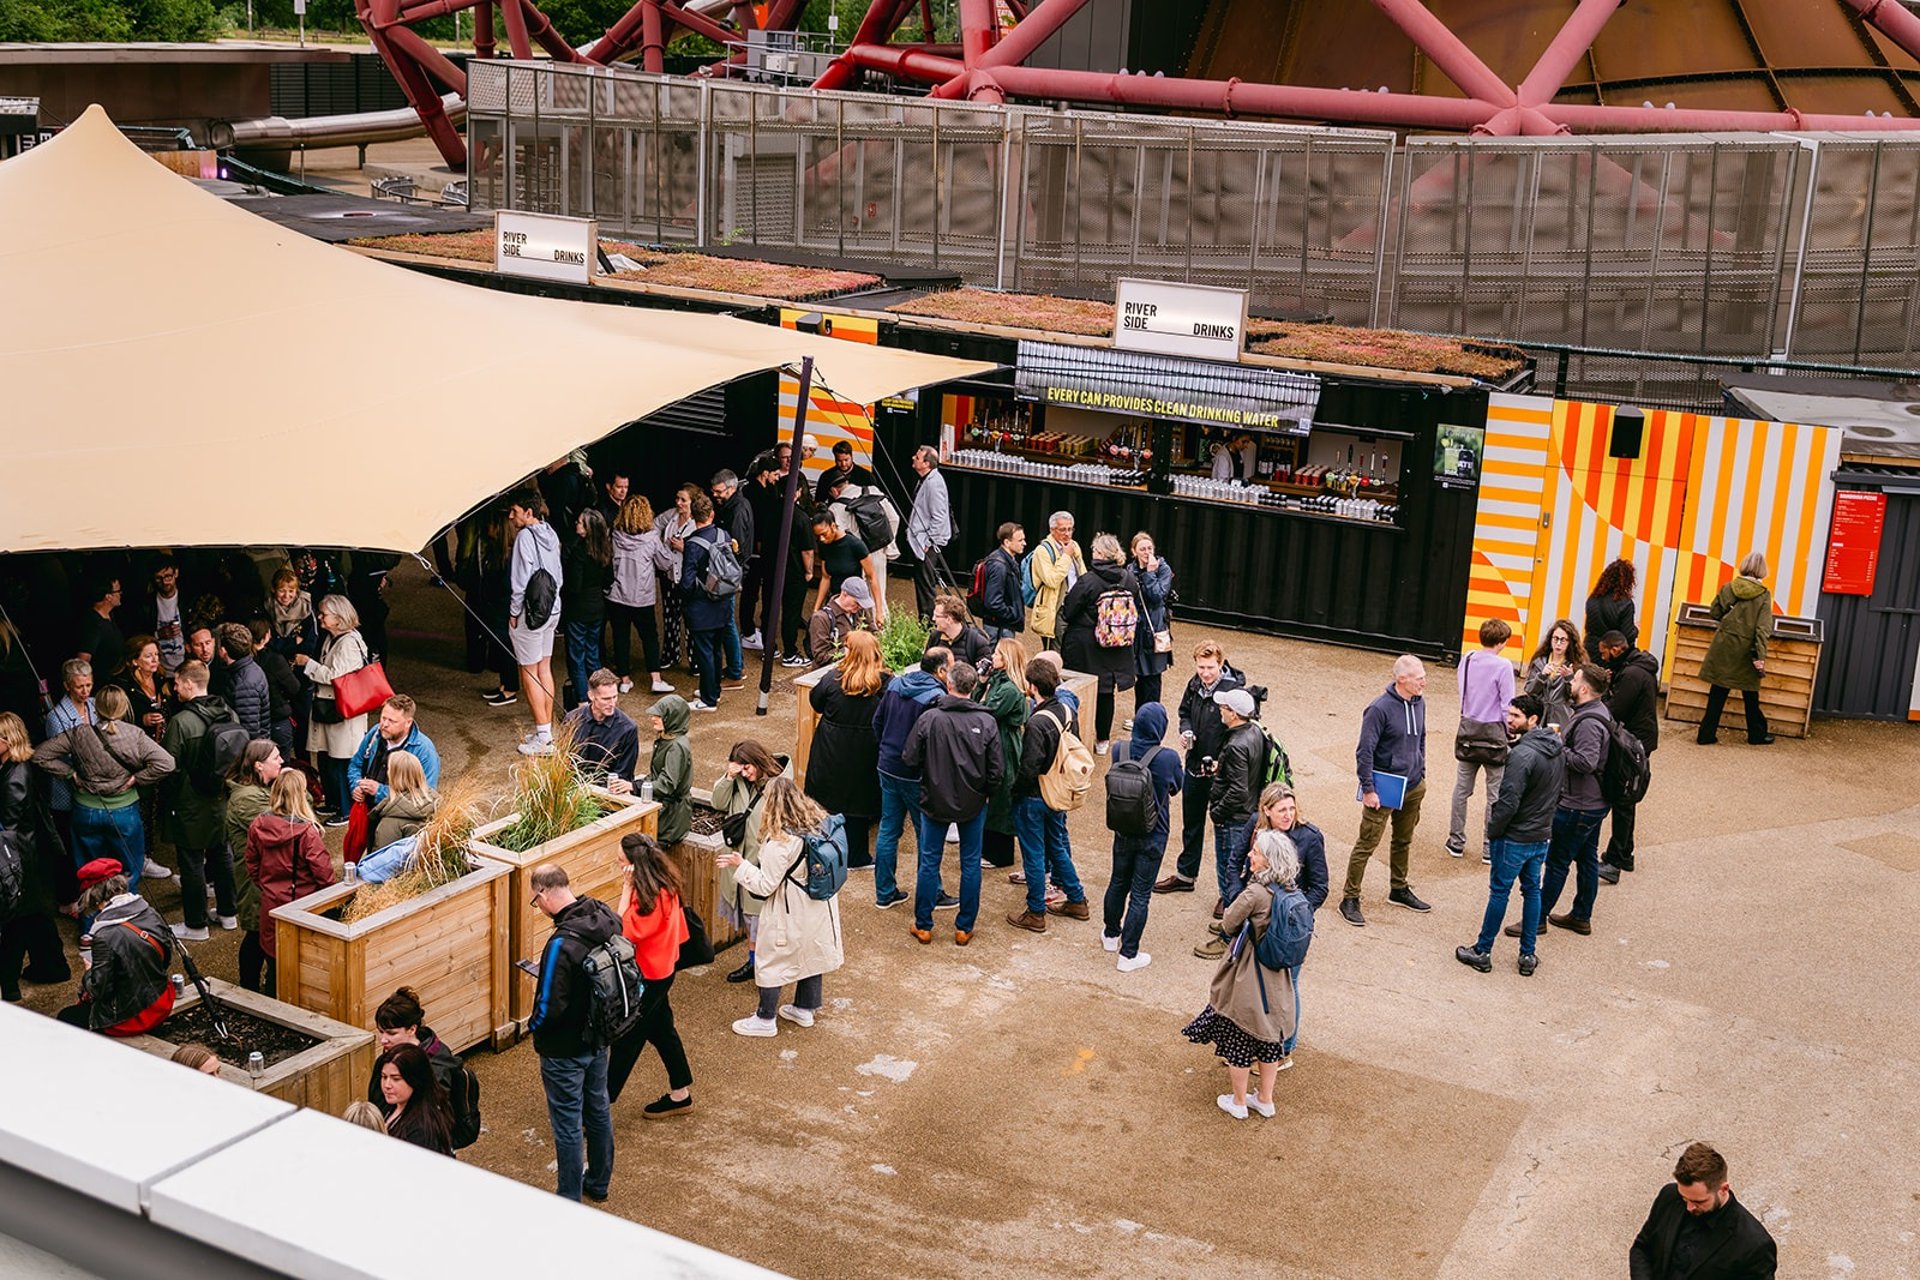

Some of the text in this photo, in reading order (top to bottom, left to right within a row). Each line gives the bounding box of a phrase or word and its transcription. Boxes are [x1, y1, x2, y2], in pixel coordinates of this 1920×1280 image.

[503, 231, 527, 245] RIVER
[503, 243, 585, 264] SIDE DRINKS
[1125, 301, 1157, 317] RIVER
[1123, 315, 1235, 339] SIDE DRINKS
[1047, 387, 1079, 402] EVERY
[1080, 390, 1102, 407] CAN
[1103, 394, 1153, 412] PROVIDES
[1154, 400, 1187, 417] CLEAN
[1189, 404, 1241, 423] DRINKING
[1242, 411, 1279, 428] WATER
